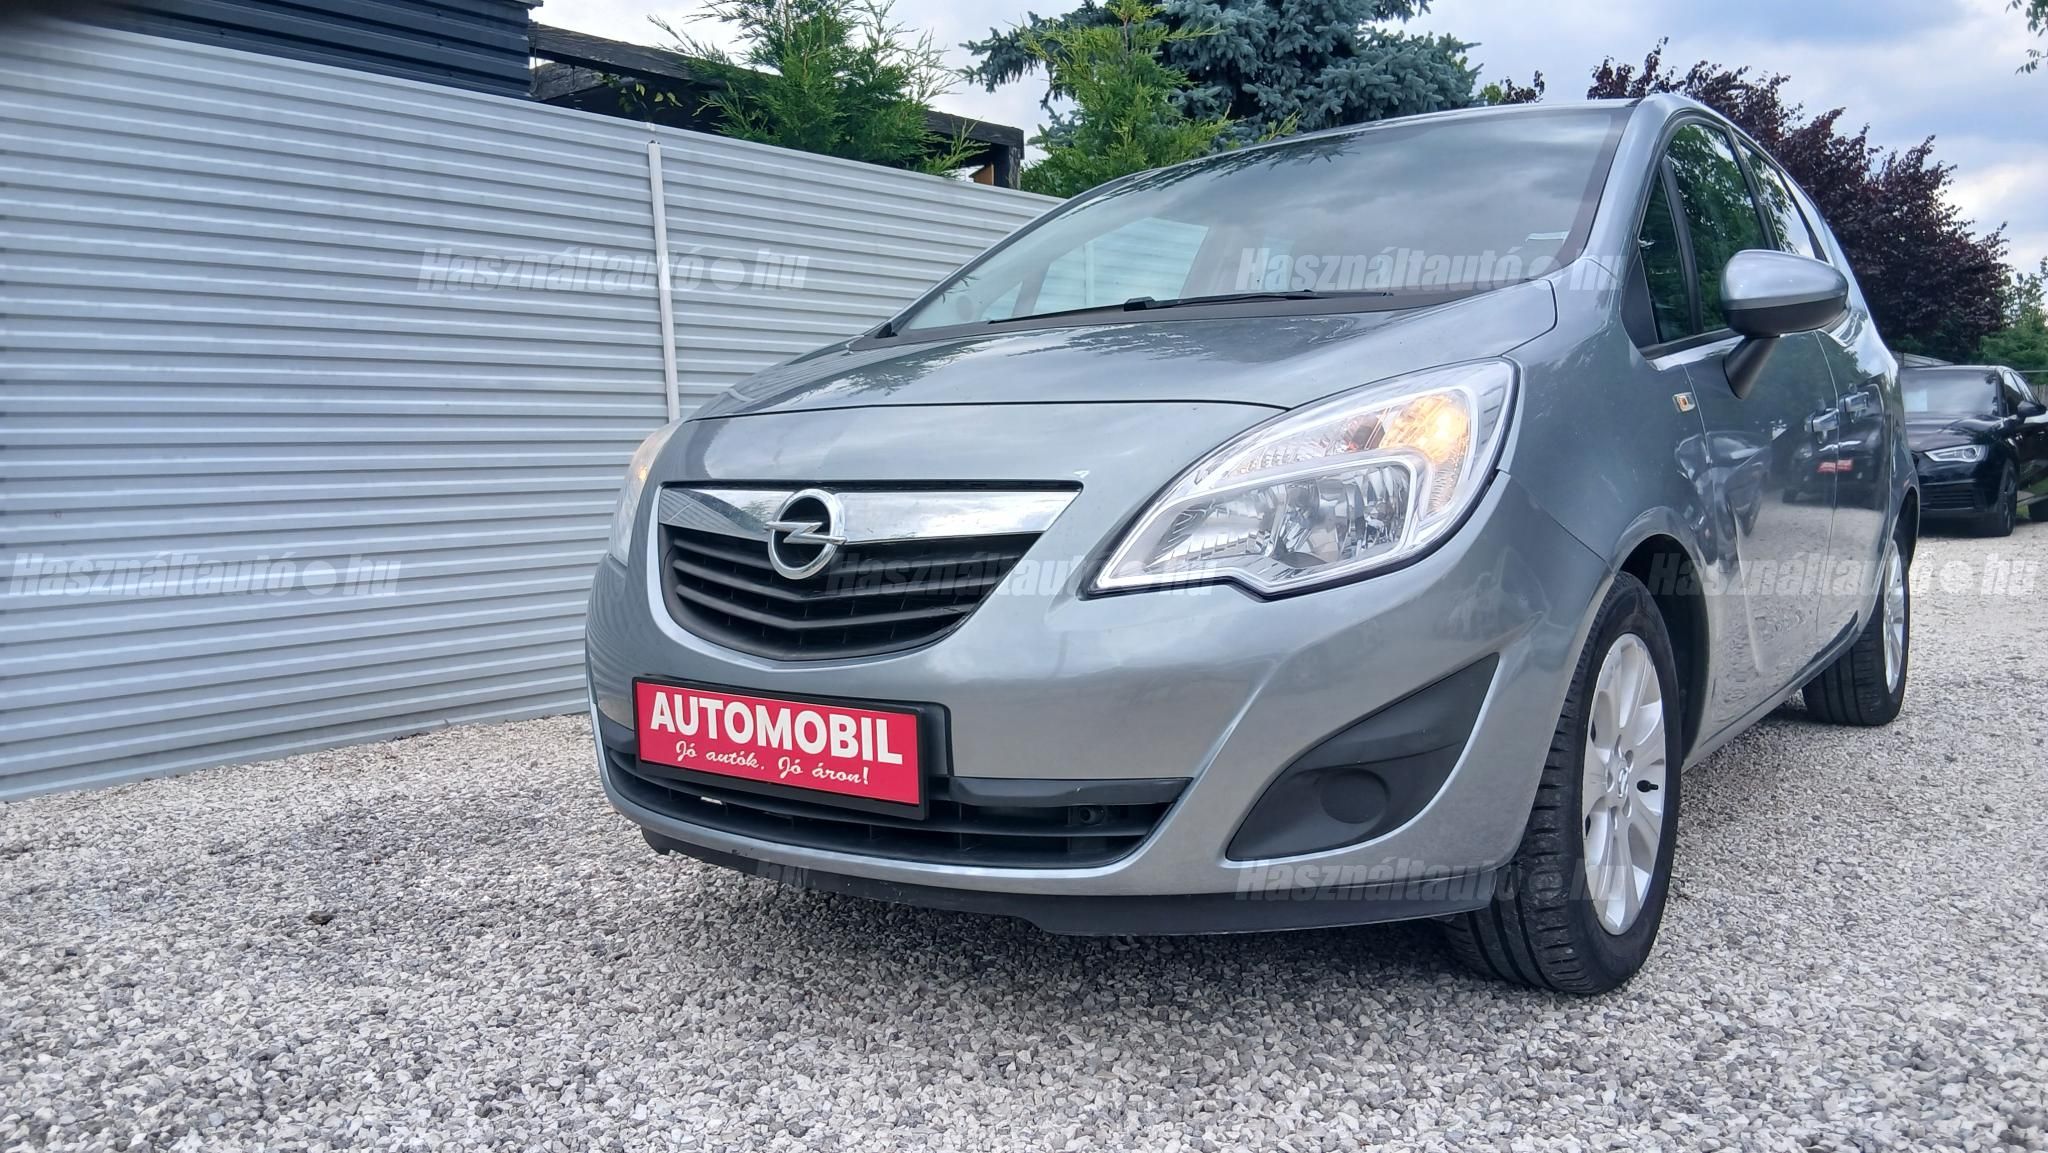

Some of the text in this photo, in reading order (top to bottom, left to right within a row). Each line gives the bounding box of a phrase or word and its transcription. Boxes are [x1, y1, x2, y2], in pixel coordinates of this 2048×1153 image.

[650, 691, 902, 764] AUTOMOBIL
[675, 740, 697, 762] Jó
[778, 756, 803, 779] Jó
[812, 763, 869, 785] áron!
